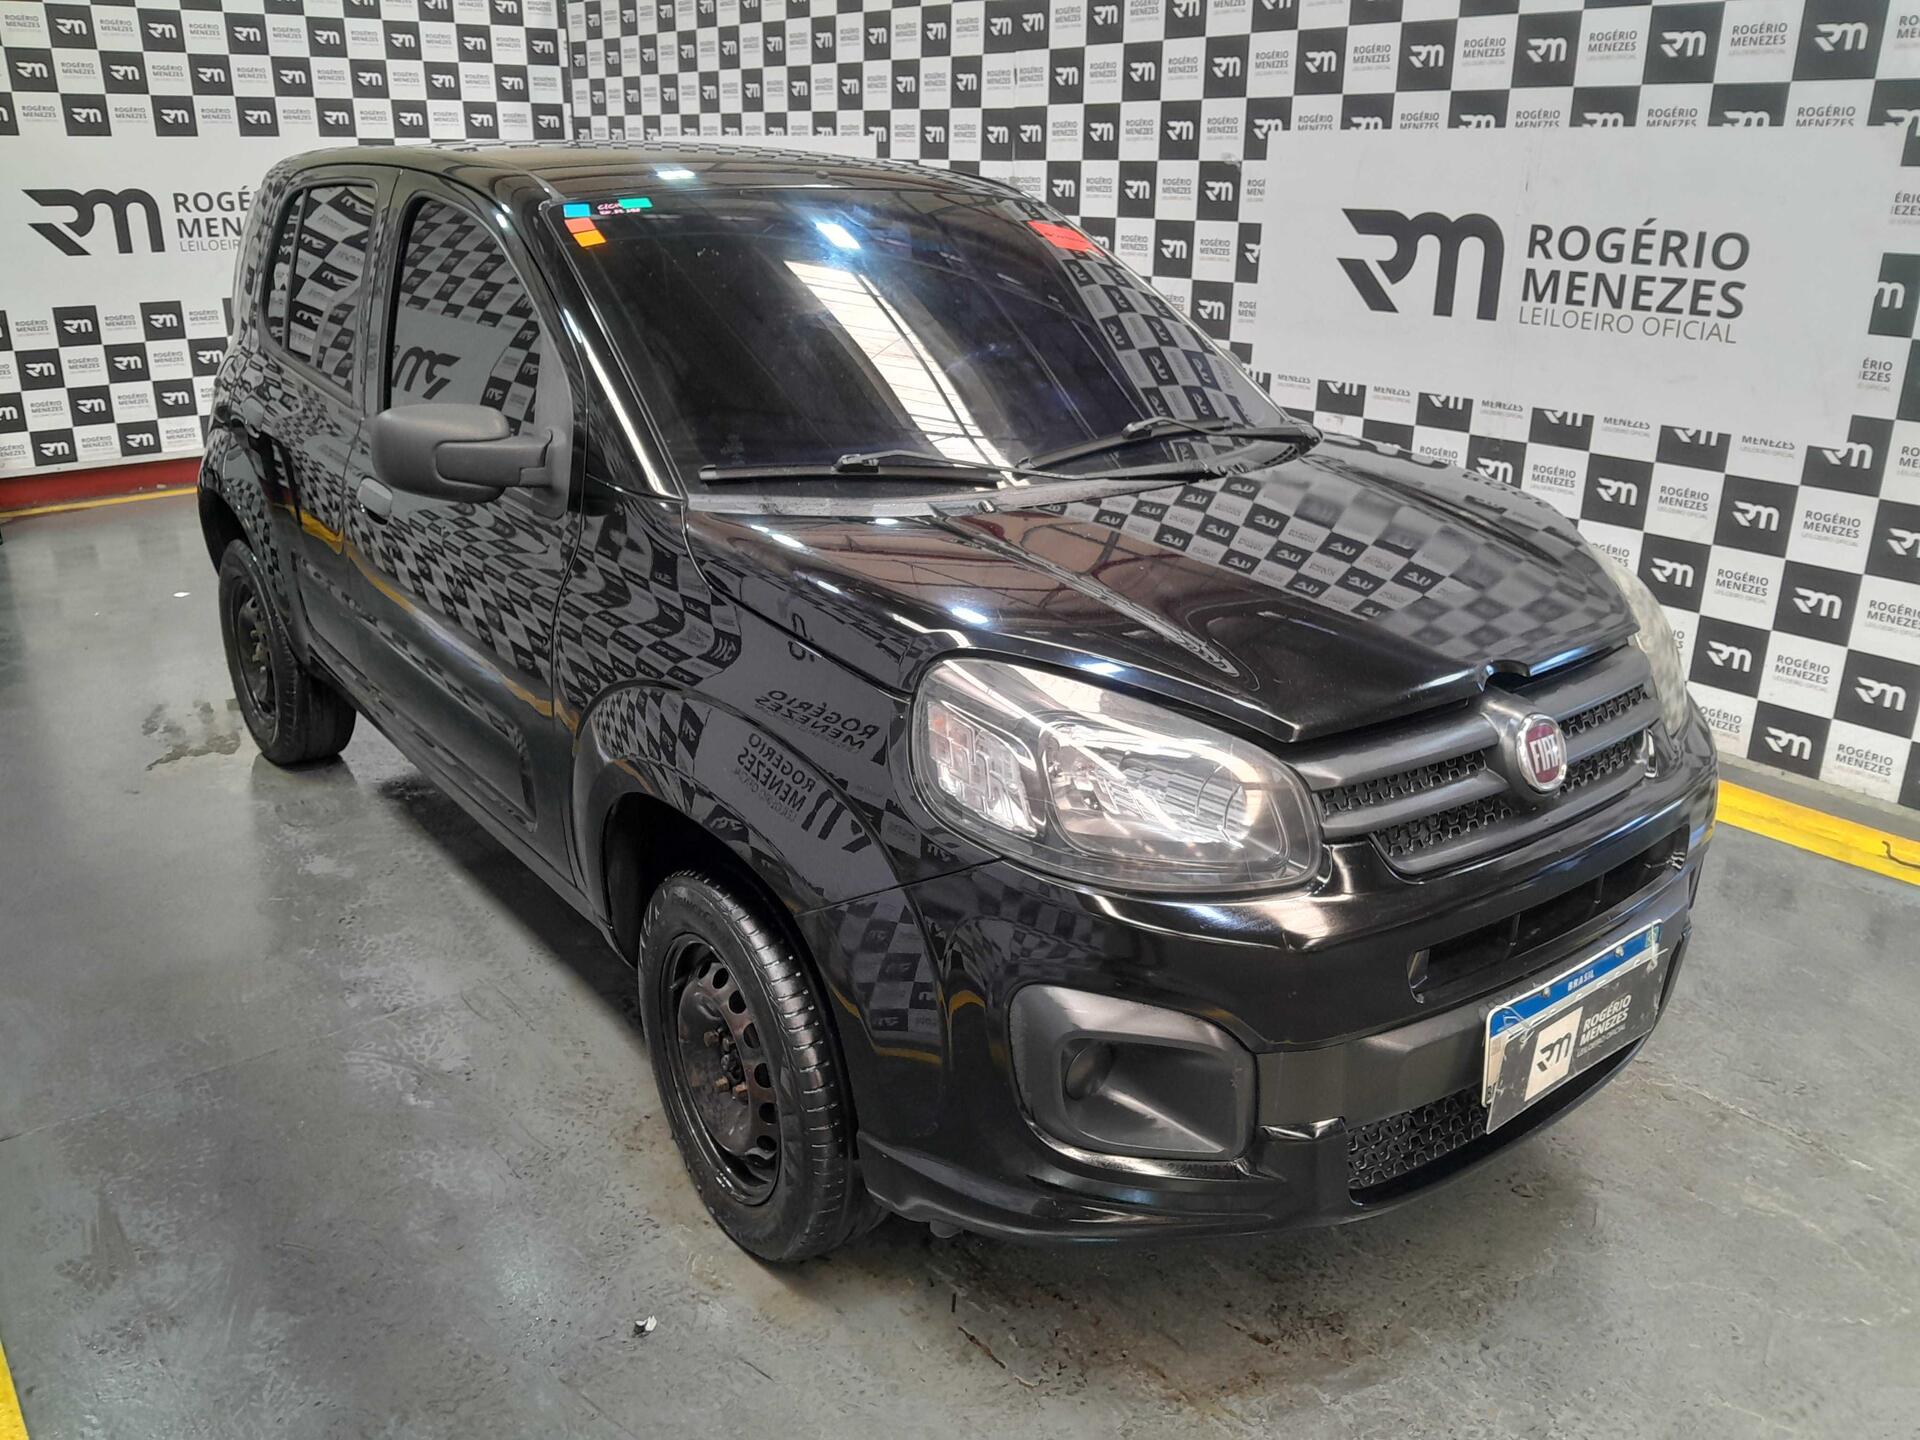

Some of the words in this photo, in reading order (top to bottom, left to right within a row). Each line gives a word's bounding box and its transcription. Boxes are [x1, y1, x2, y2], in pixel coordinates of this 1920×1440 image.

[1588, 30, 1637, 42] ROGÉRIO
[1732, 23, 1788, 37] ROGÉRIO
[1354, 44, 1391, 53] ROGÉRIO
[1463, 36, 1506, 48] ROGÉRIO
[1588, 41, 1636, 53] MENEZES
[1731, 35, 1787, 48] MENEZES
[1256, 49, 1288, 60] ROGÉRIO
[1353, 54, 1391, 64] MENEZES
[1463, 48, 1505, 59] MENEZES
[1255, 60, 1288, 69] MENEZES
[1298, 113, 1333, 123] ROGÉRIO
[1400, 111, 1439, 122] ROGÉRIO
[1516, 108, 1560, 121] ROGÉRIO
[1648, 106, 1697, 119] ROGÉRIO
[1797, 104, 1856, 118] ROGÉRIO
[173, 186, 250, 213] ROGÉ
[180, 239, 240, 252] LEILOEIR
[1121, 234, 1148, 243] ROGÉRIO
[1200, 238, 1230, 247] ROGÉRIO
[1527, 218, 1750, 271] ROGÉRIO
[1121, 242, 1147, 250] MENEZES
[1200, 247, 1230, 256] MENEZES
[1521, 268, 1747, 319] MENEZES
[1518, 306, 1634, 334] LEILOEIRO
[1642, 316, 1737, 344] OFICIAL
[1862, 357, 1893, 371] ÉRIO
[1859, 371, 1891, 383] EZES
[1419, 445, 1458, 459] ROGÉRIO
[1533, 464, 1576, 479] ROGÉRIO
[1531, 474, 1576, 488] MENEZES
[1660, 485, 1710, 501] ROGÉRIO
[1658, 495, 1708, 511] MENEZES
[1805, 510, 1861, 528] ROGÉRIO
[1803, 521, 1860, 539] MENEZES
[1717, 569, 1769, 586] ROGÉRIO
[1715, 578, 1768, 597] MENEZES
[1867, 610, 1920, 630] MENEZE
[1777, 655, 1830, 675] ROGÉRIO
[1774, 665, 1829, 685] MENEZES
[1700, 706, 1742, 724] OGÉRIO
[1708, 718, 1740, 733] NEZES
[1529, 734, 1559, 773] FIAT
[1838, 743, 1893, 766] ROGÉRIO
[1835, 754, 1892, 777] MENEZES
[1568, 970, 1594, 991] BRASIL
[1583, 995, 1631, 1032] ROGÉRIO
[1580, 1008, 1629, 1046] MENEZES
